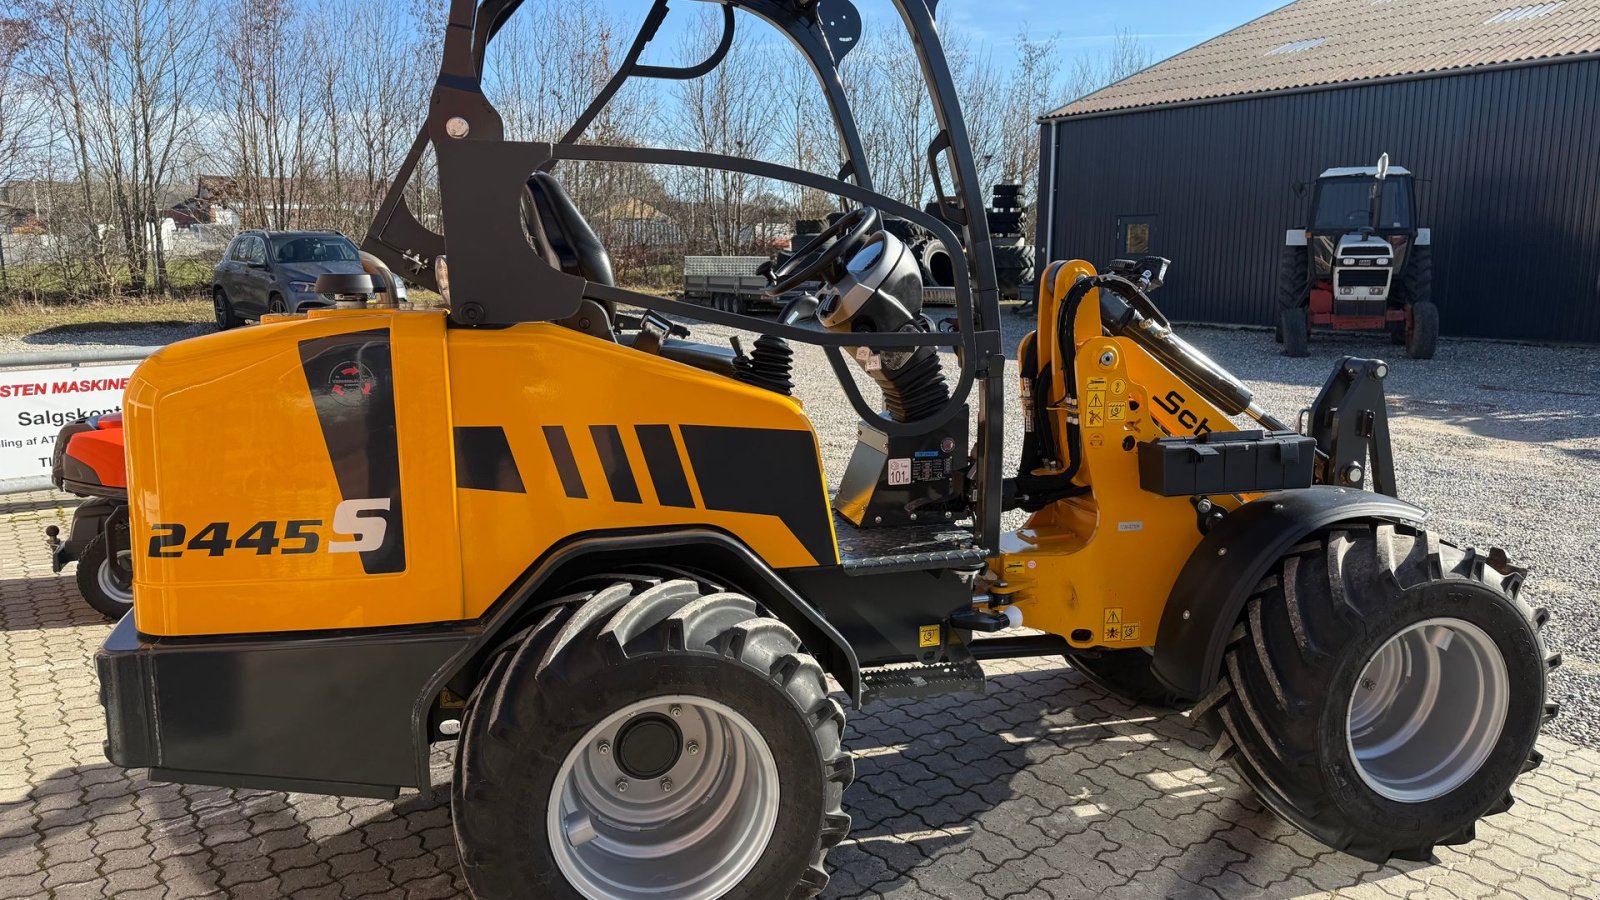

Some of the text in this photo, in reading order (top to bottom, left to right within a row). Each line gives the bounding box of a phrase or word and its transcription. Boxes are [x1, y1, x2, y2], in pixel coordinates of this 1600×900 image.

[26, 437, 37, 446] af
[41, 435, 59, 444] AT
[890, 470, 905, 483] 101
[147, 497, 391, 558] 2445 S
